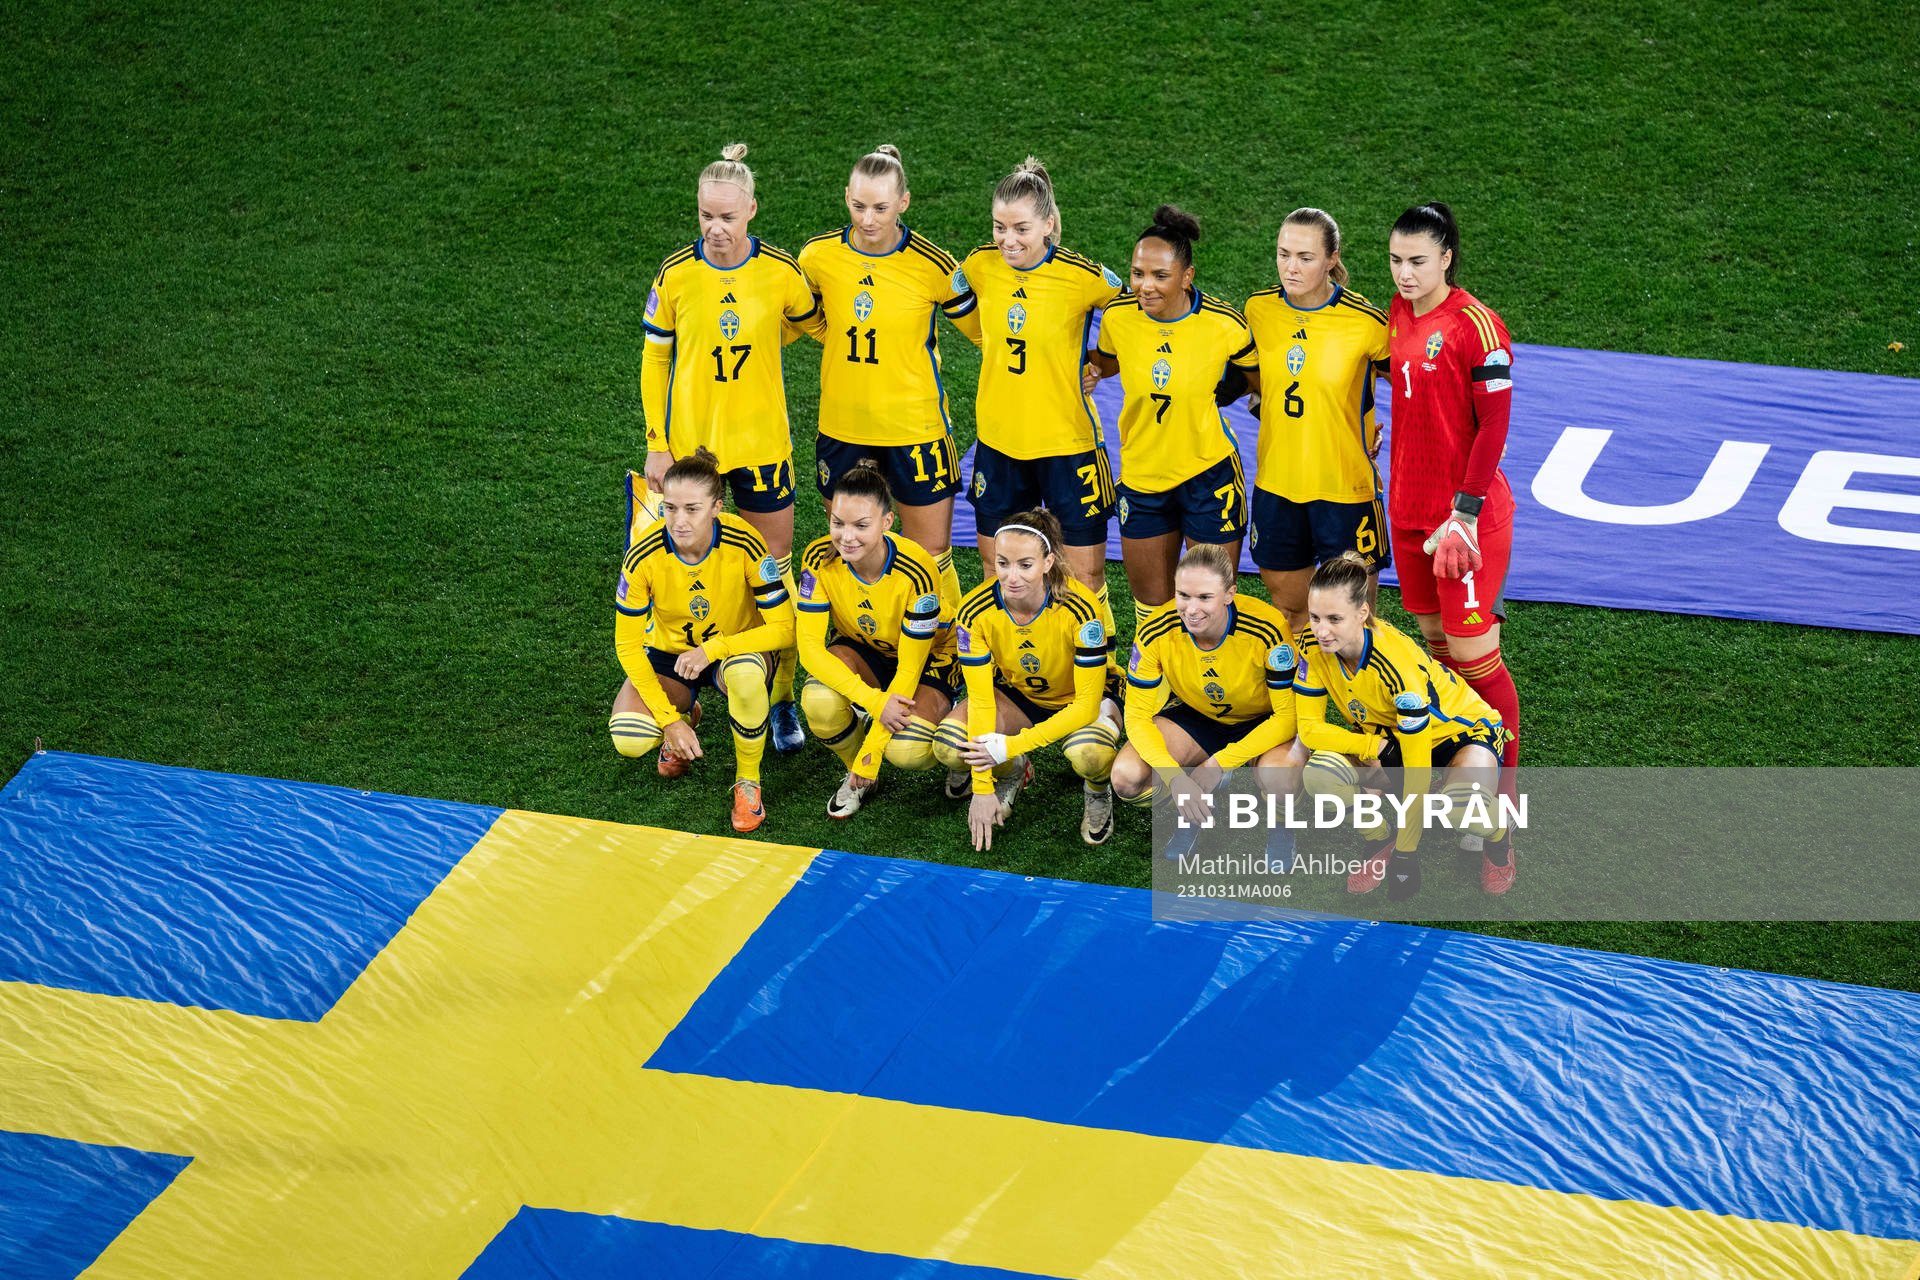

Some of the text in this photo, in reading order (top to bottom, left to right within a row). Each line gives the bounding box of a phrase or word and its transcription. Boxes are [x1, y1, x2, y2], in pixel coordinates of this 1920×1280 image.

[712, 344, 752, 383] 17
[846, 326, 879, 364] 11
[1005, 337, 1026, 375] 3
[1402, 360, 1412, 399] 1
[1150, 393, 1172, 425] 7
[1284, 381, 1305, 419] 6
[746, 463, 783, 492] 17
[910, 442, 947, 482] 11
[1077, 464, 1101, 504] 3
[1213, 483, 1235, 519] 7
[1356, 515, 1377, 553] 6
[1462, 571, 1480, 608] 1
[1025, 676, 1050, 693] 9
